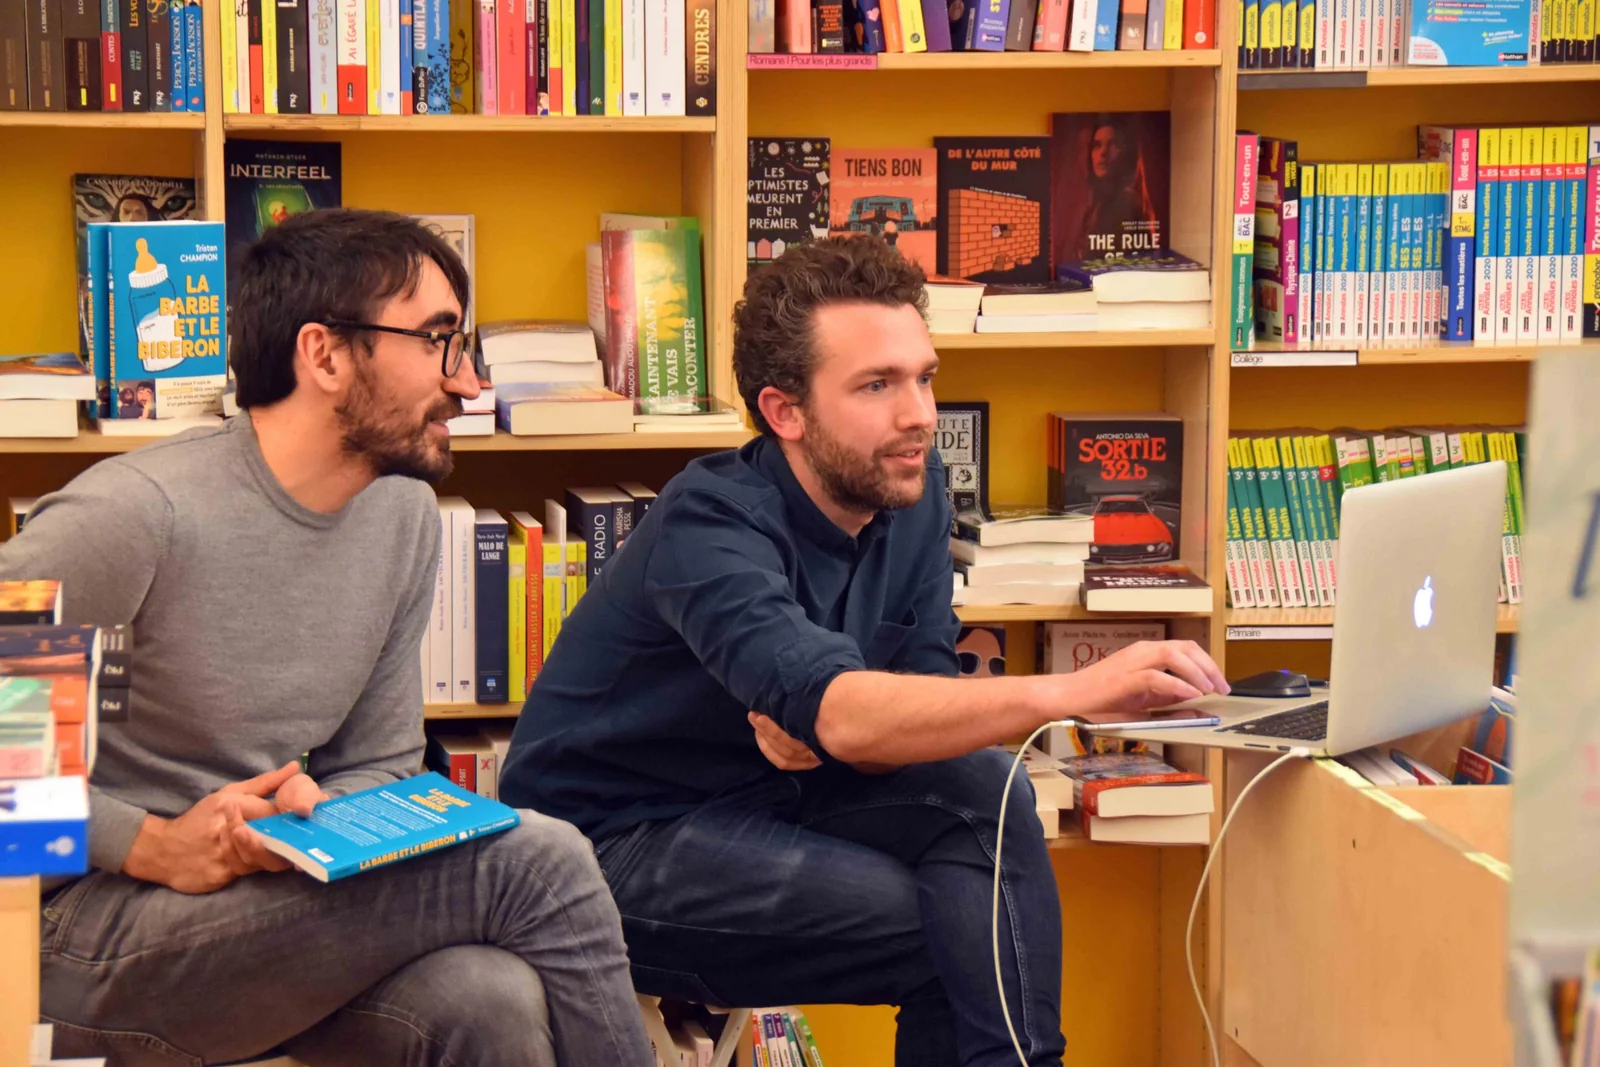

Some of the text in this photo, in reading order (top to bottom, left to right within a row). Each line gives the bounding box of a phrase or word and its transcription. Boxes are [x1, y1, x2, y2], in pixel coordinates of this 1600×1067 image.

[344, 12, 356, 42] ÉGARÉ
[172, 16, 182, 89] PERCY JACKSON
[186, 13, 197, 87] PERCY JACKSON
[694, 8, 710, 85] CENDRES
[750, 56, 872, 67] Romans Pour les plus grands
[948, 146, 1041, 158] DE L'AUTRE CÔTÉ
[1458, 138, 1469, 182] Tout-en-un
[230, 163, 332, 180] INTERFEEL
[764, 167, 784, 178] LES
[845, 158, 922, 177] TIENS BON
[971, 161, 1017, 170] DU MUR
[1240, 145, 1252, 207] Tout-en-un
[748, 180, 808, 191] PTIMISTES
[747, 193, 803, 204] MEURENT
[1483, 184, 1491, 216] matières
[1570, 182, 1578, 215] matières
[766, 206, 782, 217] EN
[750, 218, 798, 229] PREMIER
[1242, 217, 1250, 236] BAC
[1089, 233, 1160, 250] THE RULE
[180, 253, 217, 262] CHAMPION
[1286, 240, 1297, 295] Physique-Chimie
[1400, 247, 1410, 268] SES
[1413, 247, 1422, 268] SES
[186, 274, 209, 294] LA
[1456, 243, 1466, 310] Toutes les matières
[159, 295, 219, 316] BARBE
[1236, 284, 1246, 323] Enseignements
[174, 317, 219, 337] ET LE
[138, 338, 220, 360] BIBERON
[684, 317, 698, 398] ACONTER
[1233, 354, 1263, 364] Collège
[666, 348, 678, 387] VAIS
[936, 419, 969, 430] UTE
[1078, 437, 1166, 462] SORTIE
[1101, 460, 1148, 480] 32.b
[1231, 508, 1241, 538] Maths
[1243, 508, 1254, 538] Maths
[1255, 508, 1266, 538] Maths
[1268, 508, 1279, 538] Maths
[1280, 507, 1291, 538] Maths
[594, 514, 606, 559] RADIO
[482, 552, 500, 560] LANGE
[1228, 628, 1261, 637] Primaire
[360, 835, 456, 870] LA BARBE ET LE BIBERON
